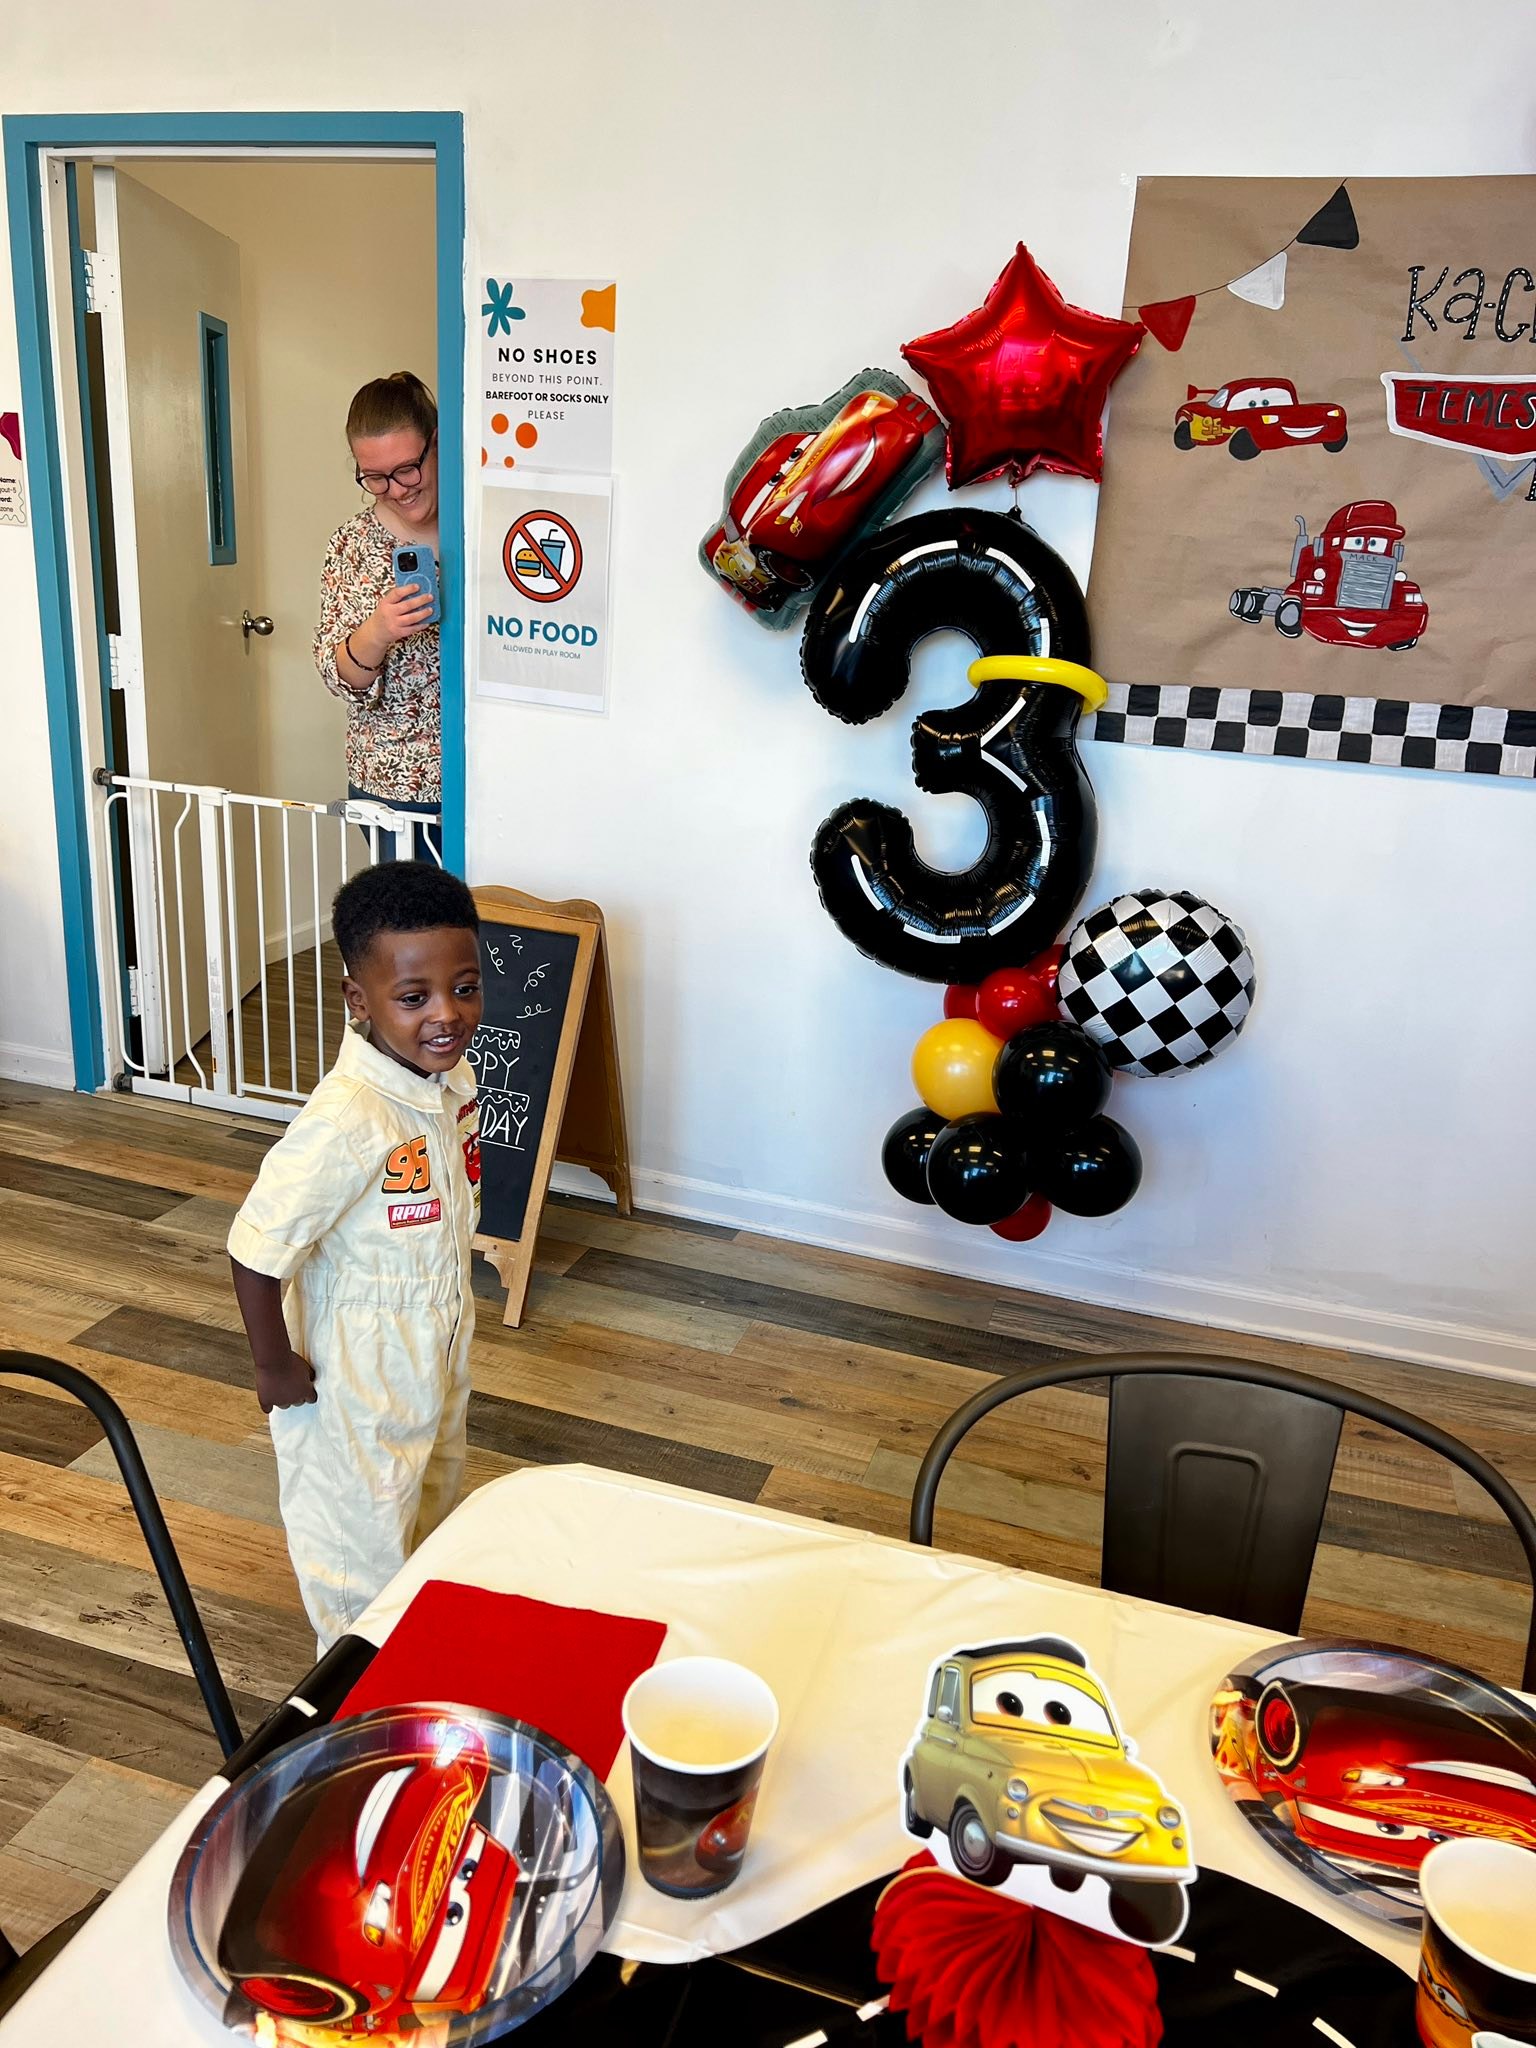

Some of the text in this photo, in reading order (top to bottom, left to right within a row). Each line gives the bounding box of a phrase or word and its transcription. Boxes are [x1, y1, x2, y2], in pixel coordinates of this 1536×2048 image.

[1401, 266, 1536, 343] Ka-C
[498, 348, 597, 365] NO SHOES
[492, 373, 603, 386] BEYOND THIS POINT.
[485, 391, 609, 404] BAREFOOT OR SOCKS ONLY
[527, 410, 565, 421] PLEASE
[1201, 416, 1222, 436] 95
[1350, 553, 1378, 562] MACK
[487, 615, 598, 647] NO FOOD
[502, 644, 581, 660] ALLOWED IN PLAY ROOM
[465, 1048, 520, 1091] PPY
[478, 1104, 529, 1146] DAY
[381, 1135, 431, 1194] 95
[391, 1203, 432, 1221] RPM
